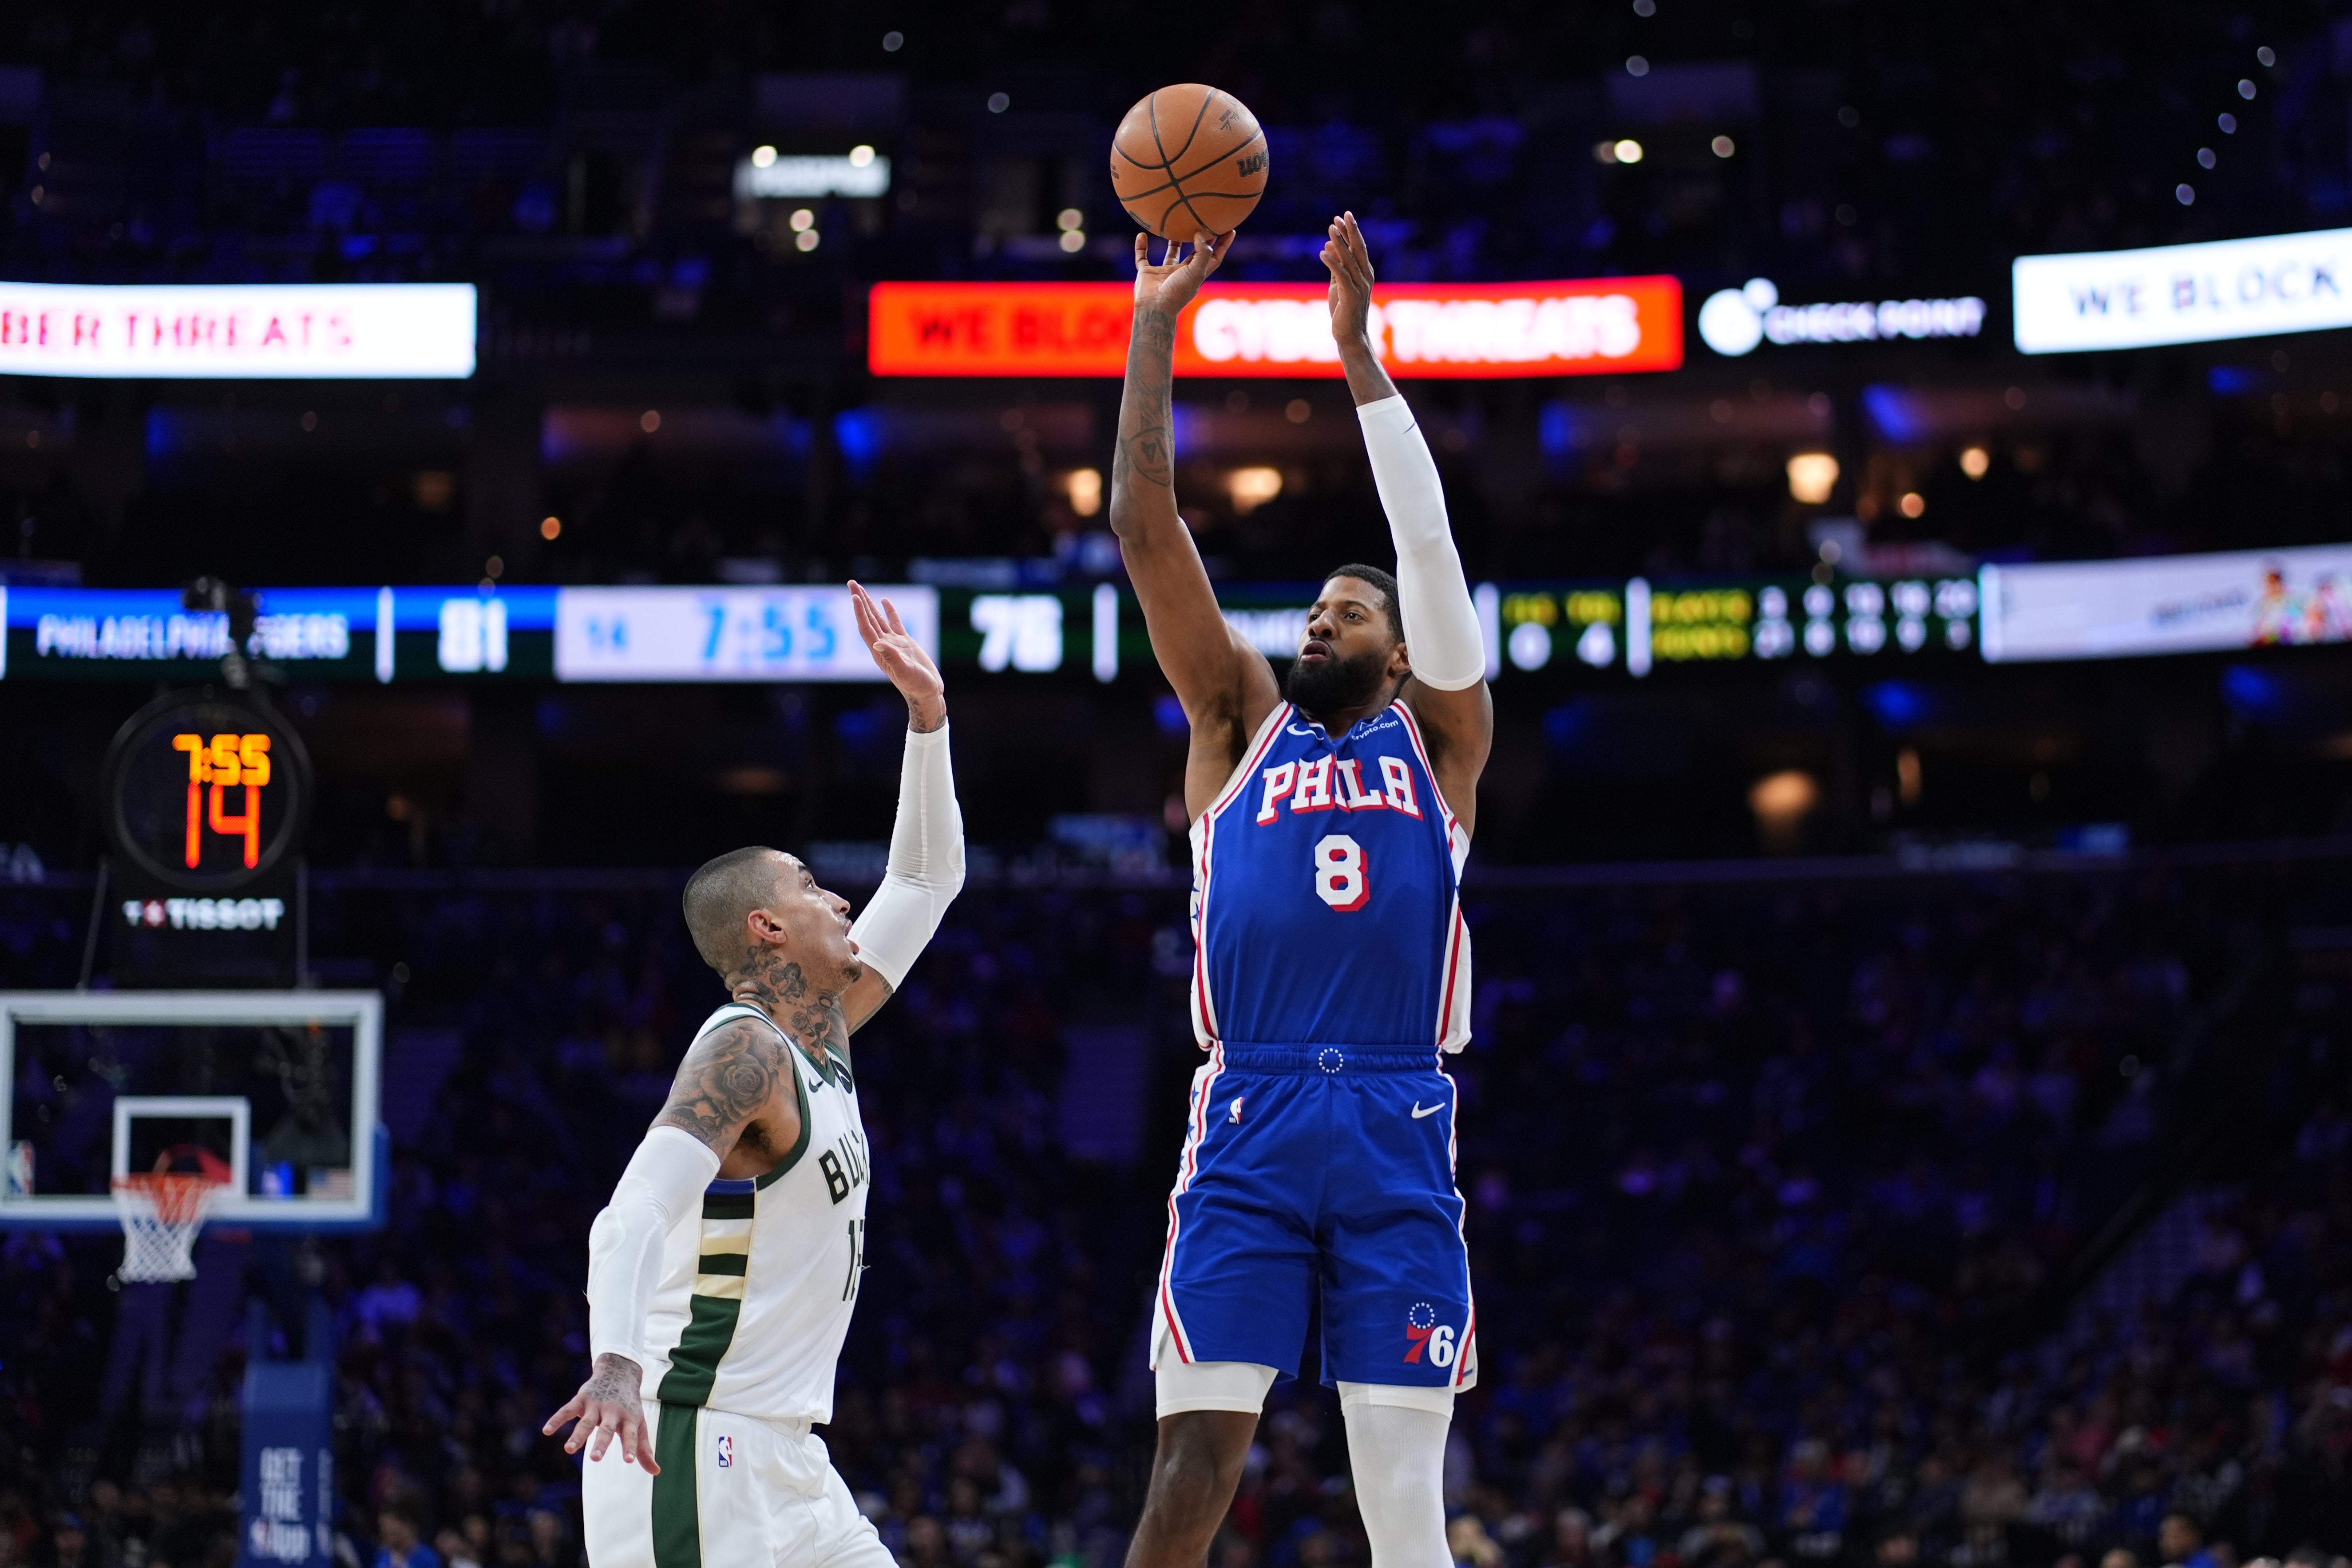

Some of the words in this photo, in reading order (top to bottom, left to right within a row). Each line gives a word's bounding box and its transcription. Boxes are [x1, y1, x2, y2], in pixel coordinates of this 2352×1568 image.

[2067, 274, 2148, 318] WE
[2169, 261, 2343, 312] BLOCK
[116, 311, 353, 348] THREATS
[1012, 304, 1133, 354] BLOC
[700, 594, 837, 669] 7:55
[1351, 720, 1398, 740] crypto.com
[173, 734, 270, 786] 7:55
[1256, 753, 1423, 827] PHILA
[186, 782, 260, 869] 14
[1315, 834, 1370, 912] 8
[166, 898, 285, 930] TISSOT
[1404, 1322, 1454, 1368] 76
